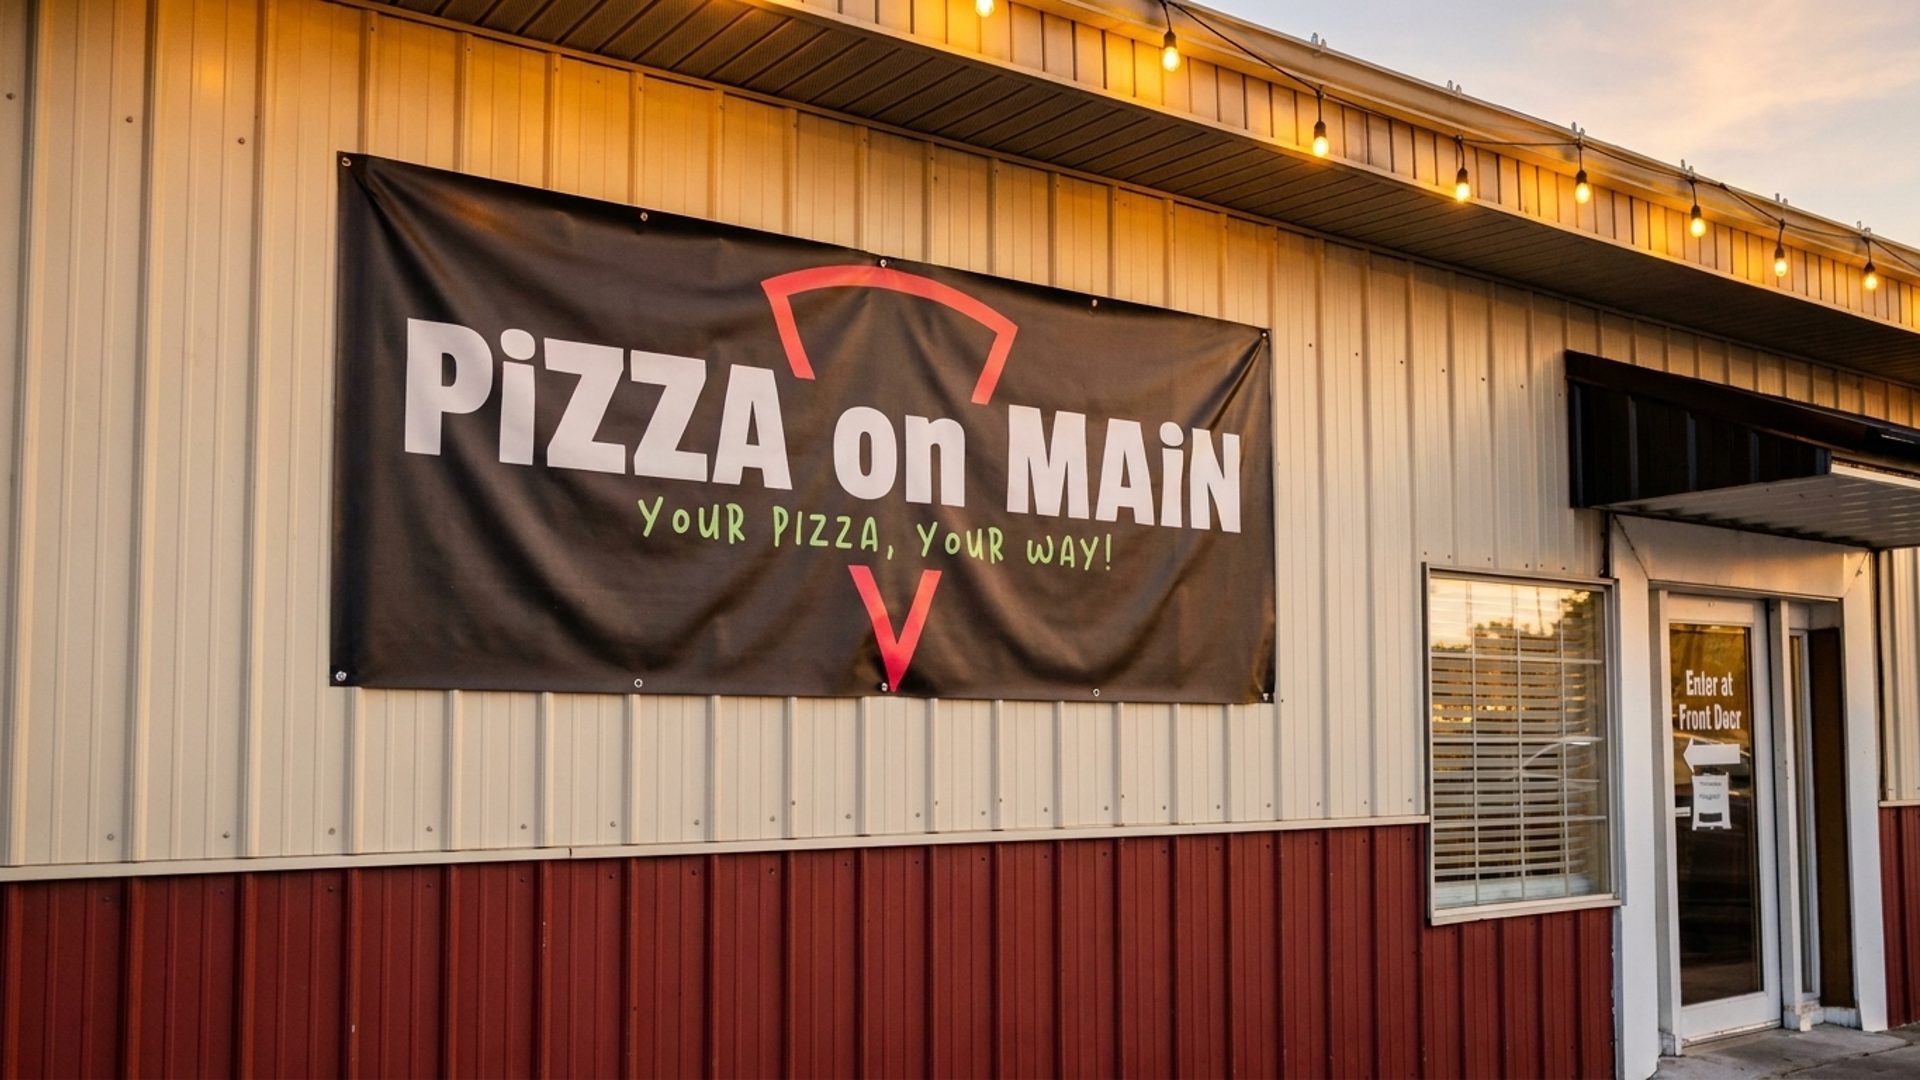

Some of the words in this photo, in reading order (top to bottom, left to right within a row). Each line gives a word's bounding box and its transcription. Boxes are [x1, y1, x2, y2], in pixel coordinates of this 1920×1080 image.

[833, 406, 966, 507] on
[773, 507, 894, 559] PIZZA,
[1026, 534, 1113, 572] WAY!
[1721, 671, 1734, 696] at
[1679, 704, 1712, 730] Front
